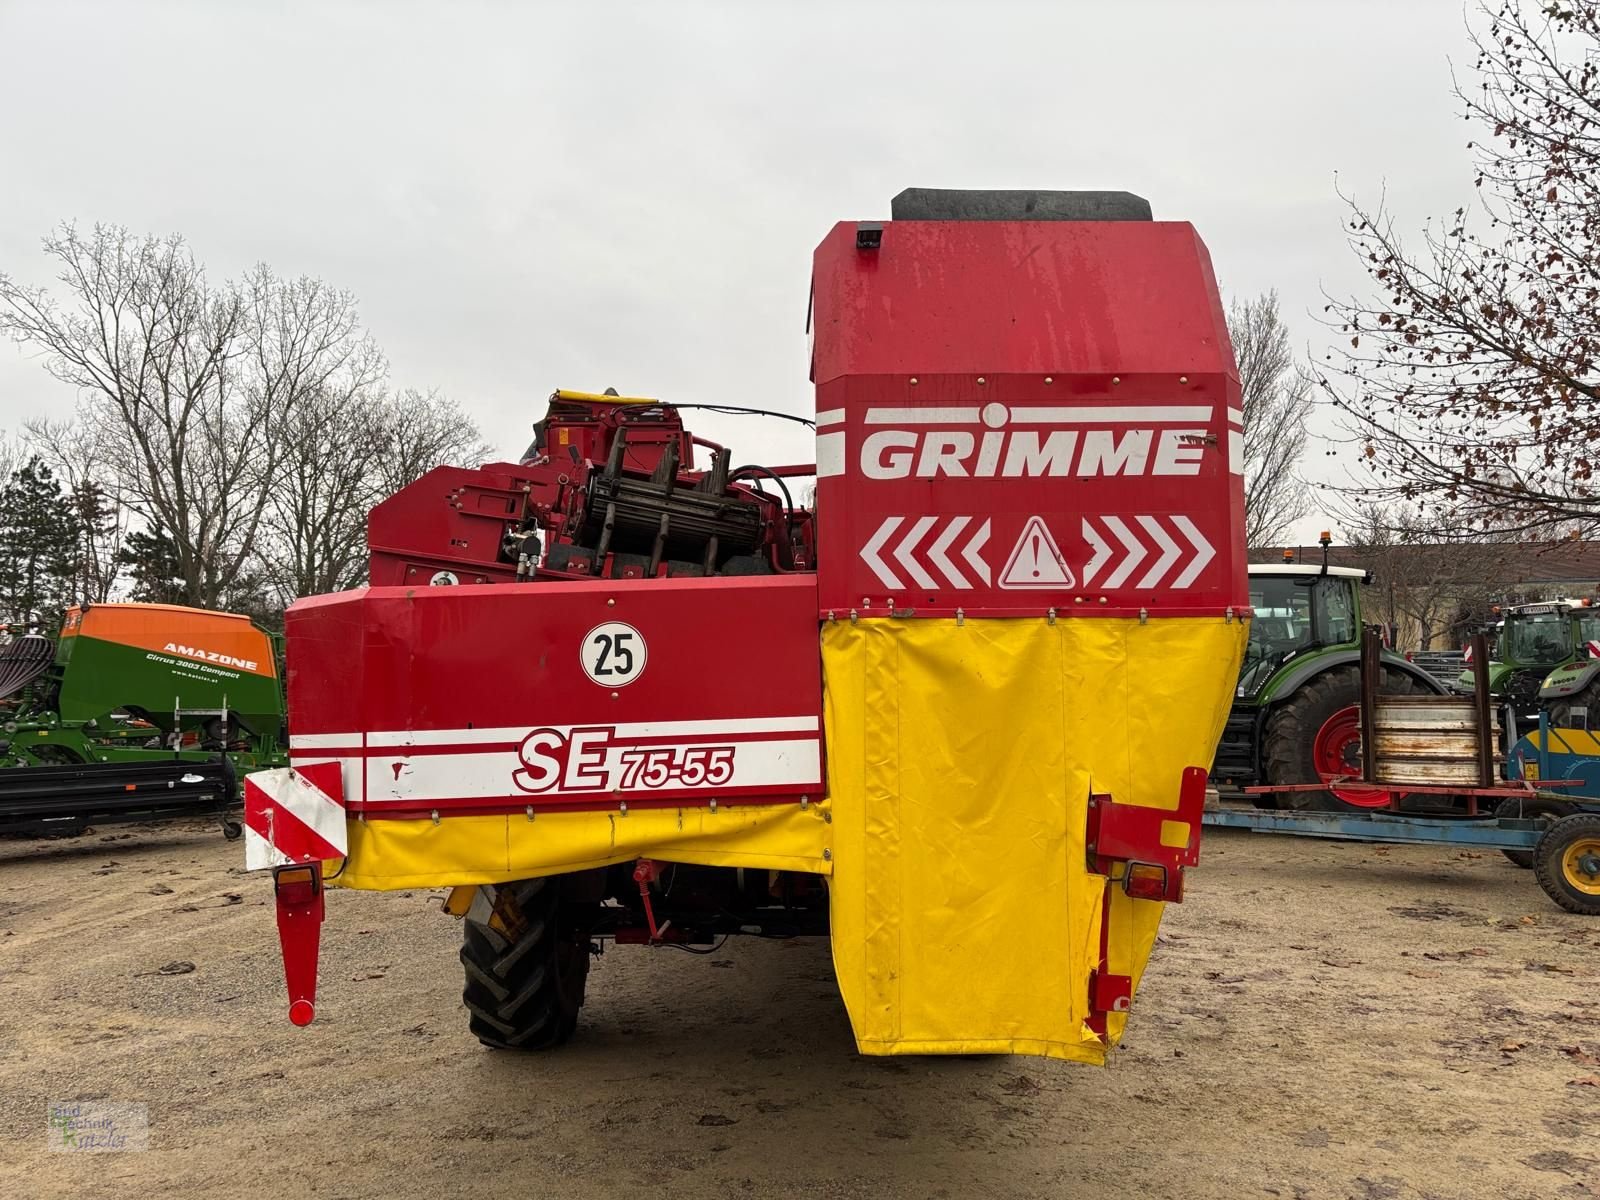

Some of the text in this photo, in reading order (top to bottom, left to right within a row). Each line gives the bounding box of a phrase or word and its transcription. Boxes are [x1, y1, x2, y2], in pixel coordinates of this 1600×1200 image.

[860, 402, 1209, 480] GRIMME
[146, 653, 240, 680] Cirrus 3003 Compact
[163, 642, 258, 671] AMAZONE
[593, 633, 633, 675] 25
[512, 726, 735, 793] SE 75-55
